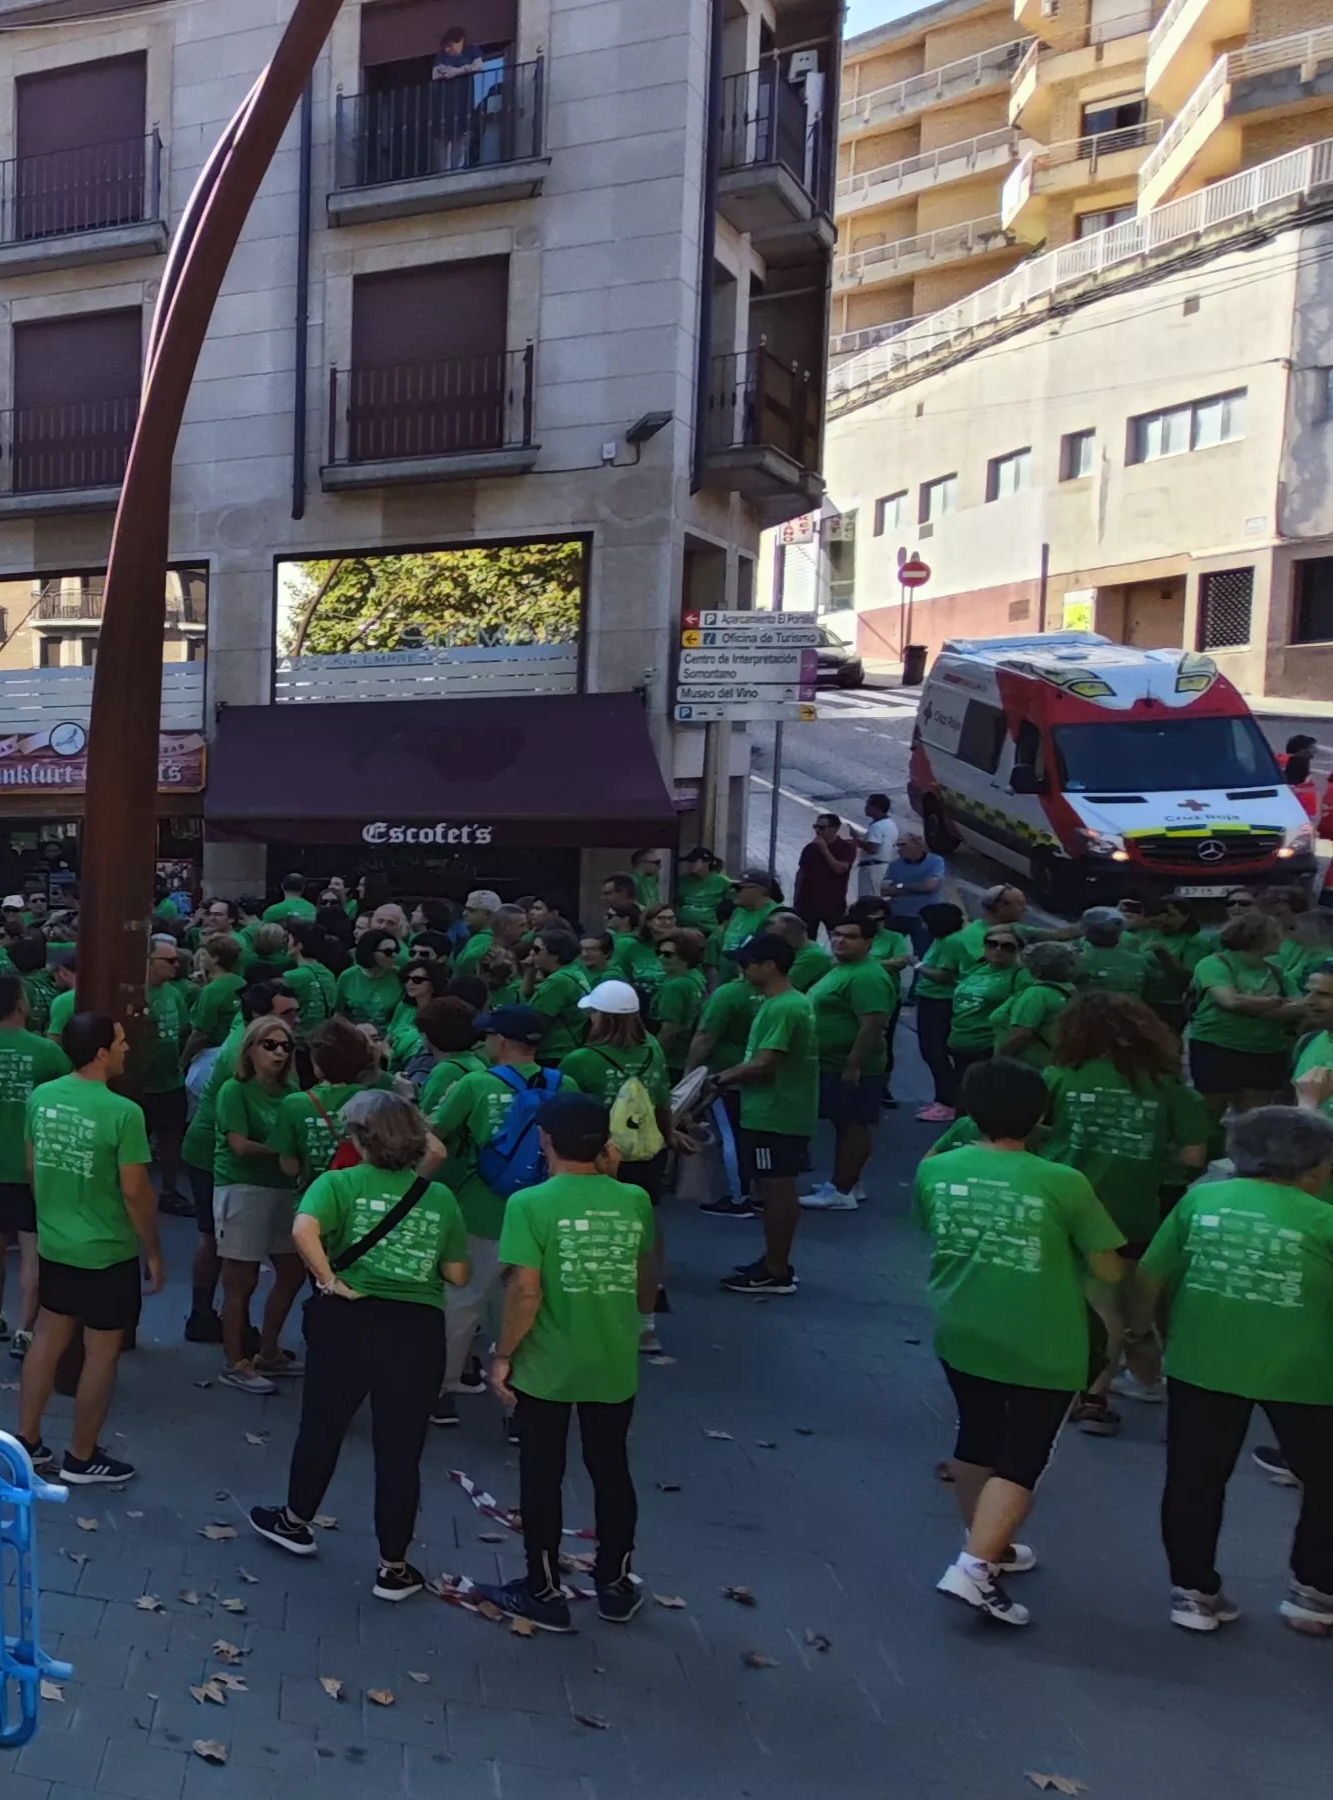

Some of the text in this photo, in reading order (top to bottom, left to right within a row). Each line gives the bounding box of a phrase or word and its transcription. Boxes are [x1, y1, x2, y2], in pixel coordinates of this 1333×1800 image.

[722, 632, 757, 643] Oficina
[760, 632, 773, 643] de
[776, 632, 816, 643] Turismo
[684, 652, 797, 666] Centro de Interpretación
[683, 669, 737, 679] Somontano
[681, 687, 759, 698] Museo del Vino
[362, 822, 493, 844] Escofet's
